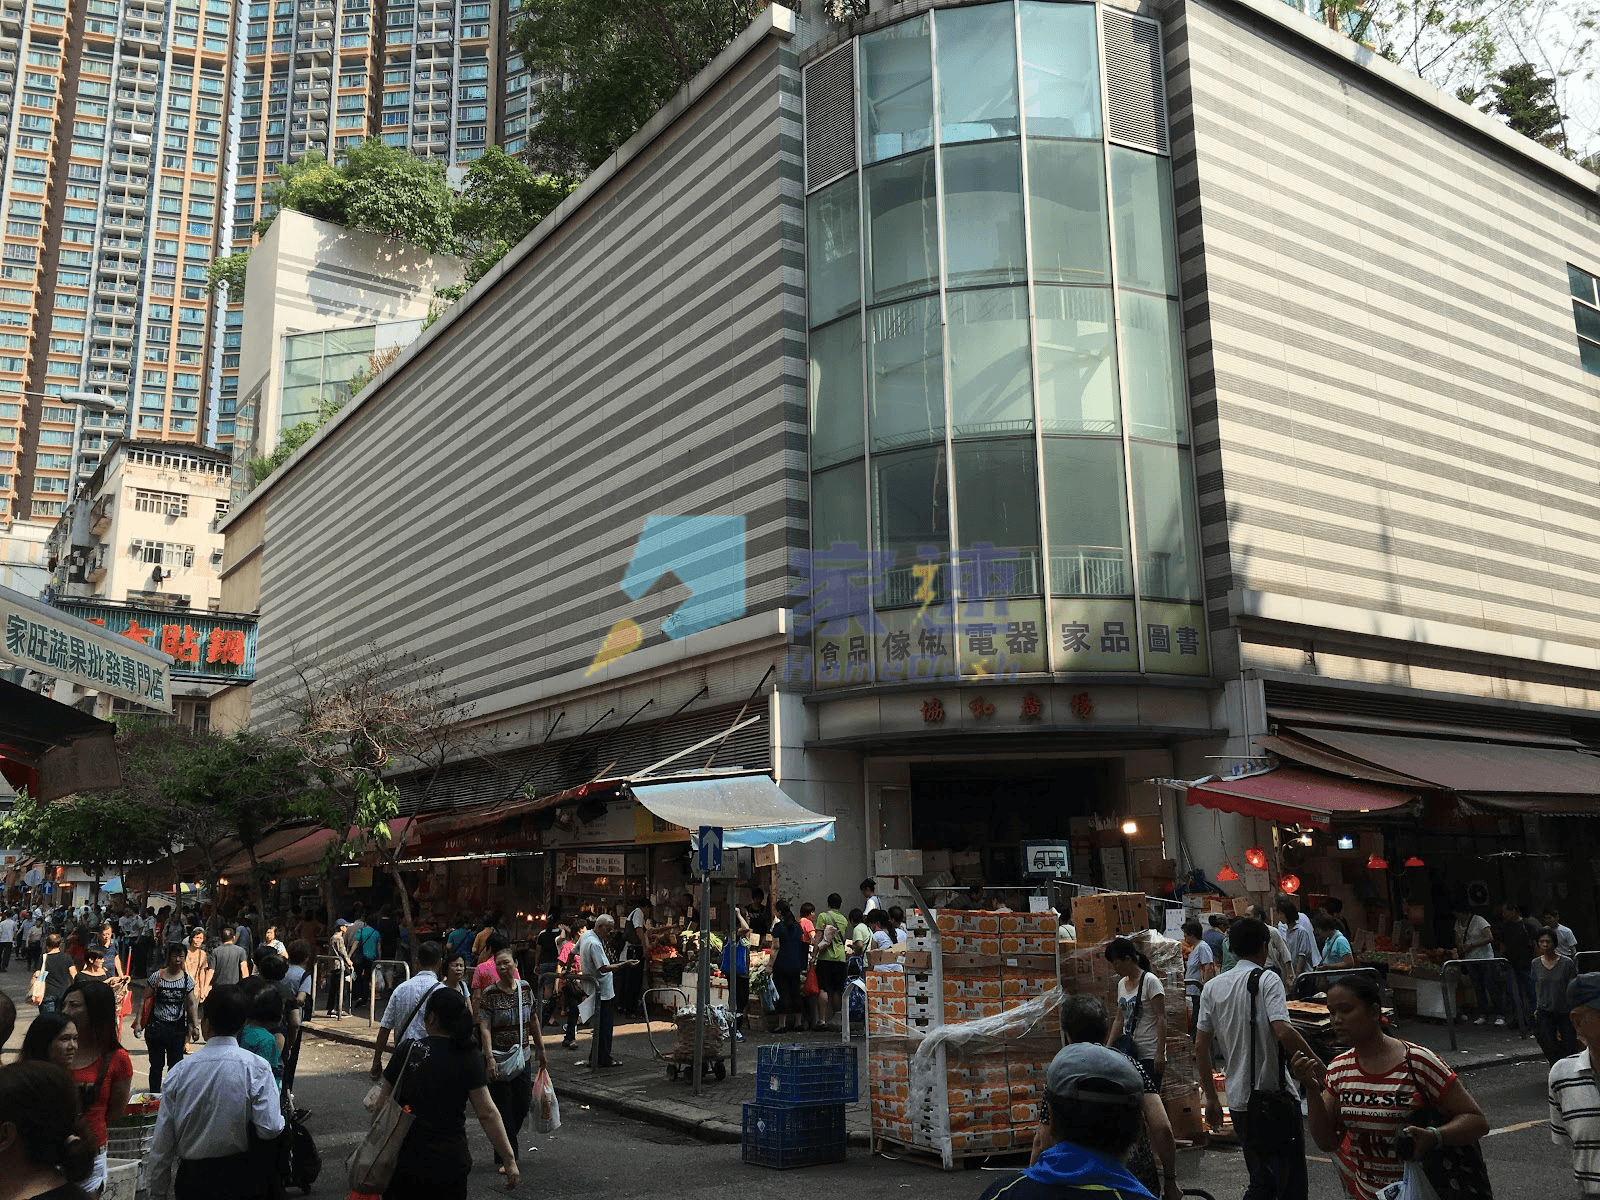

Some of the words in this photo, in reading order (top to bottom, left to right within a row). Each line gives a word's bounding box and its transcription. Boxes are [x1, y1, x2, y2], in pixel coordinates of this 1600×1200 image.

[5, 613, 165, 703] 家旺蔬果批發專門店
[820, 635, 869, 672] 食品
[965, 621, 1039, 657] 電器
[1061, 620, 1131, 653] 家品
[1147, 623, 1201, 656] 圖書
[1341, 1090, 1411, 1107] RO&SE
